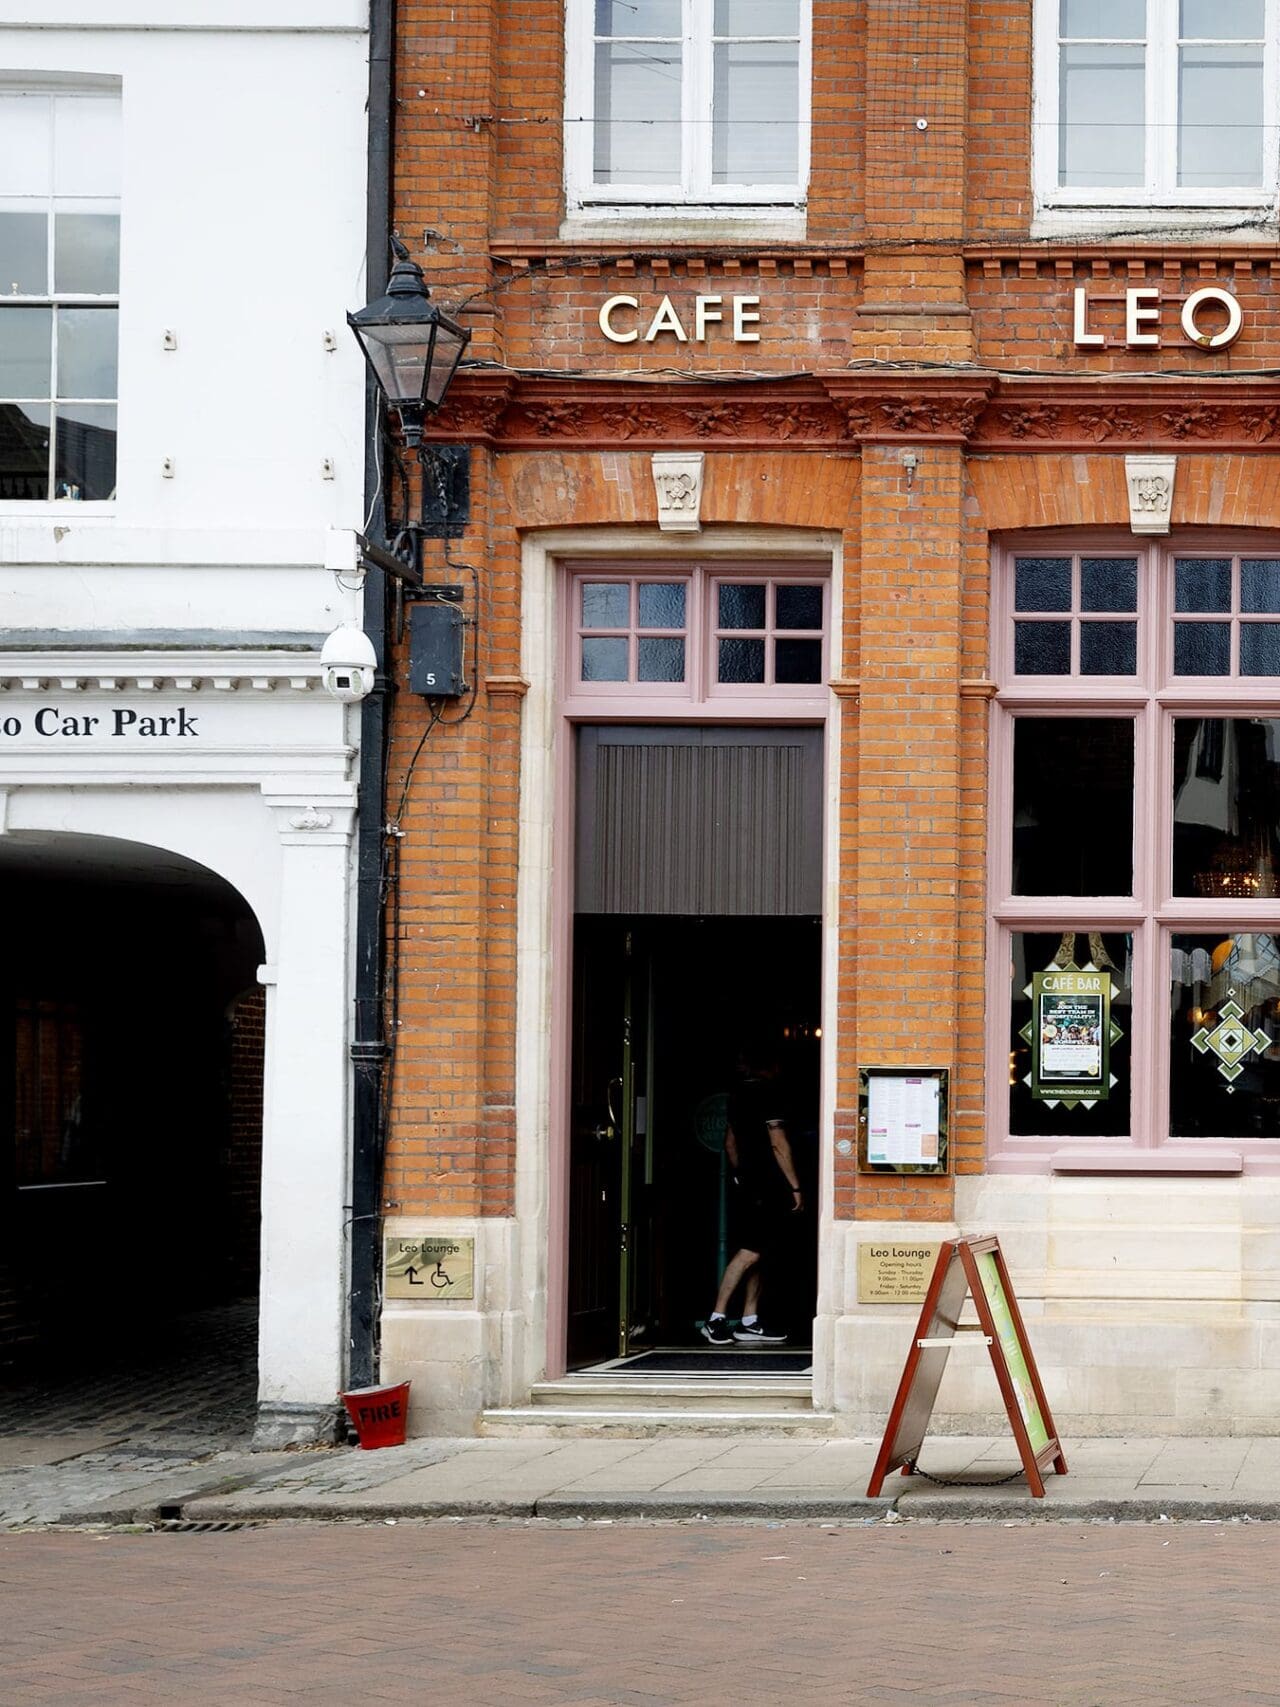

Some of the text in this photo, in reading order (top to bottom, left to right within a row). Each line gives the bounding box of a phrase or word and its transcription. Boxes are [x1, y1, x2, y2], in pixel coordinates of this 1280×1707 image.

[598, 294, 761, 344] CAFE
[1072, 287, 1244, 350] LEO
[426, 672, 436, 685] 5
[35, 707, 100, 736] Car
[111, 707, 200, 736] Park
[1042, 975, 1101, 990] CAFÉ BAR
[399, 1243, 460, 1255] Leo Lounge
[870, 1247, 931, 1260] Leo Lounge
[358, 1401, 402, 1423] FIRE
